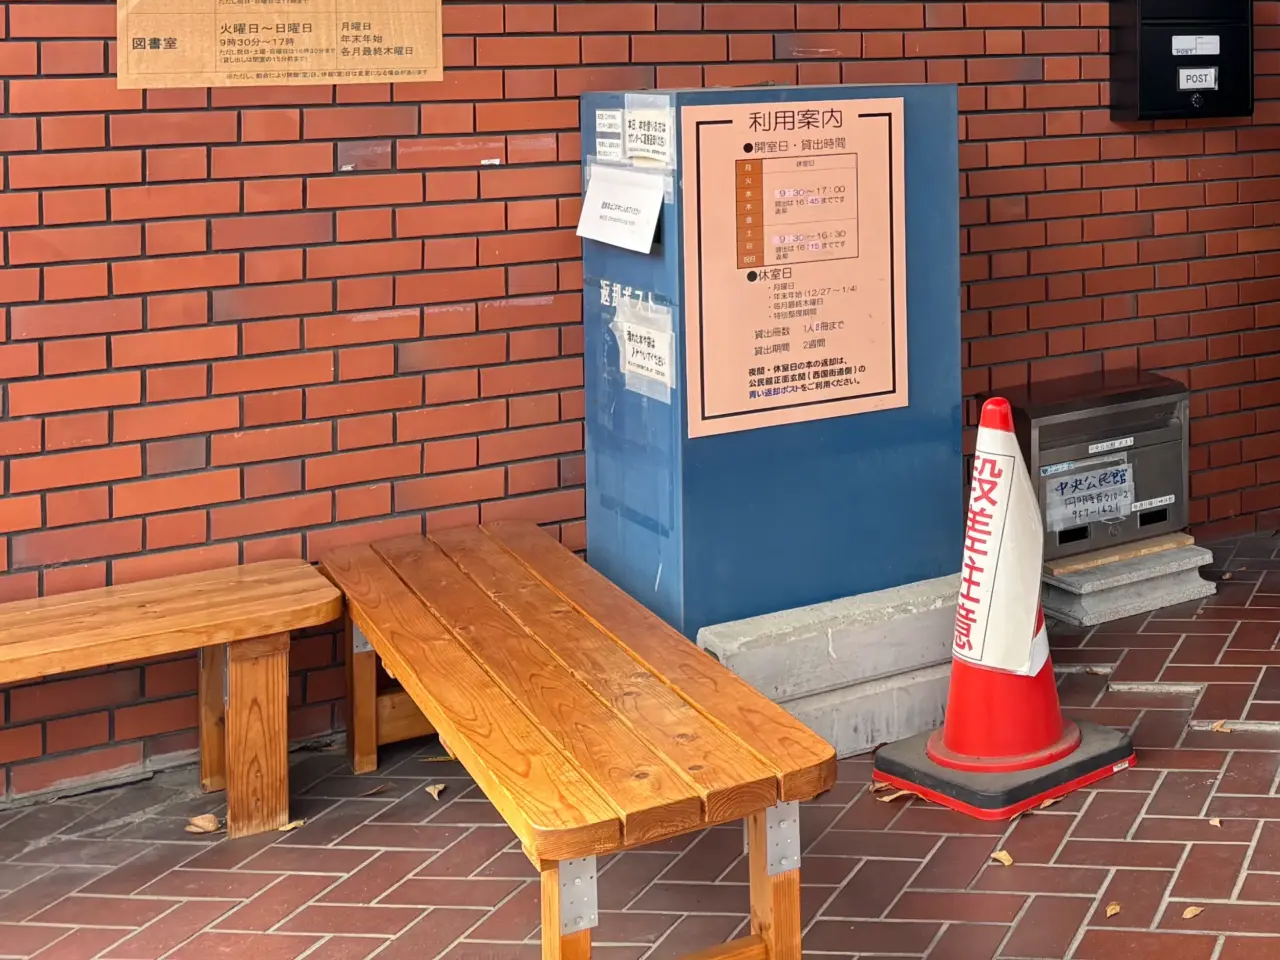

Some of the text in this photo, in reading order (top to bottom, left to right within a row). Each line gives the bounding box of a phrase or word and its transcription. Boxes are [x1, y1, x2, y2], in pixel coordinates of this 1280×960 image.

[219, 23, 313, 35] 火曜日～日曜日
[340, 21, 372, 32] 月曜日
[131, 37, 178, 51] 図書室
[340, 34, 383, 44] 年末年始
[340, 46, 414, 57] 各月最終木曜日
[1185, 74, 1209, 84] POST
[748, 107, 843, 133] 利用案内
[758, 266, 793, 282] 休室日
[754, 326, 791, 340] 貸出冊数
[754, 338, 826, 357] 貸出期間 2週間
[1055, 468, 1128, 496] 中央公民館
